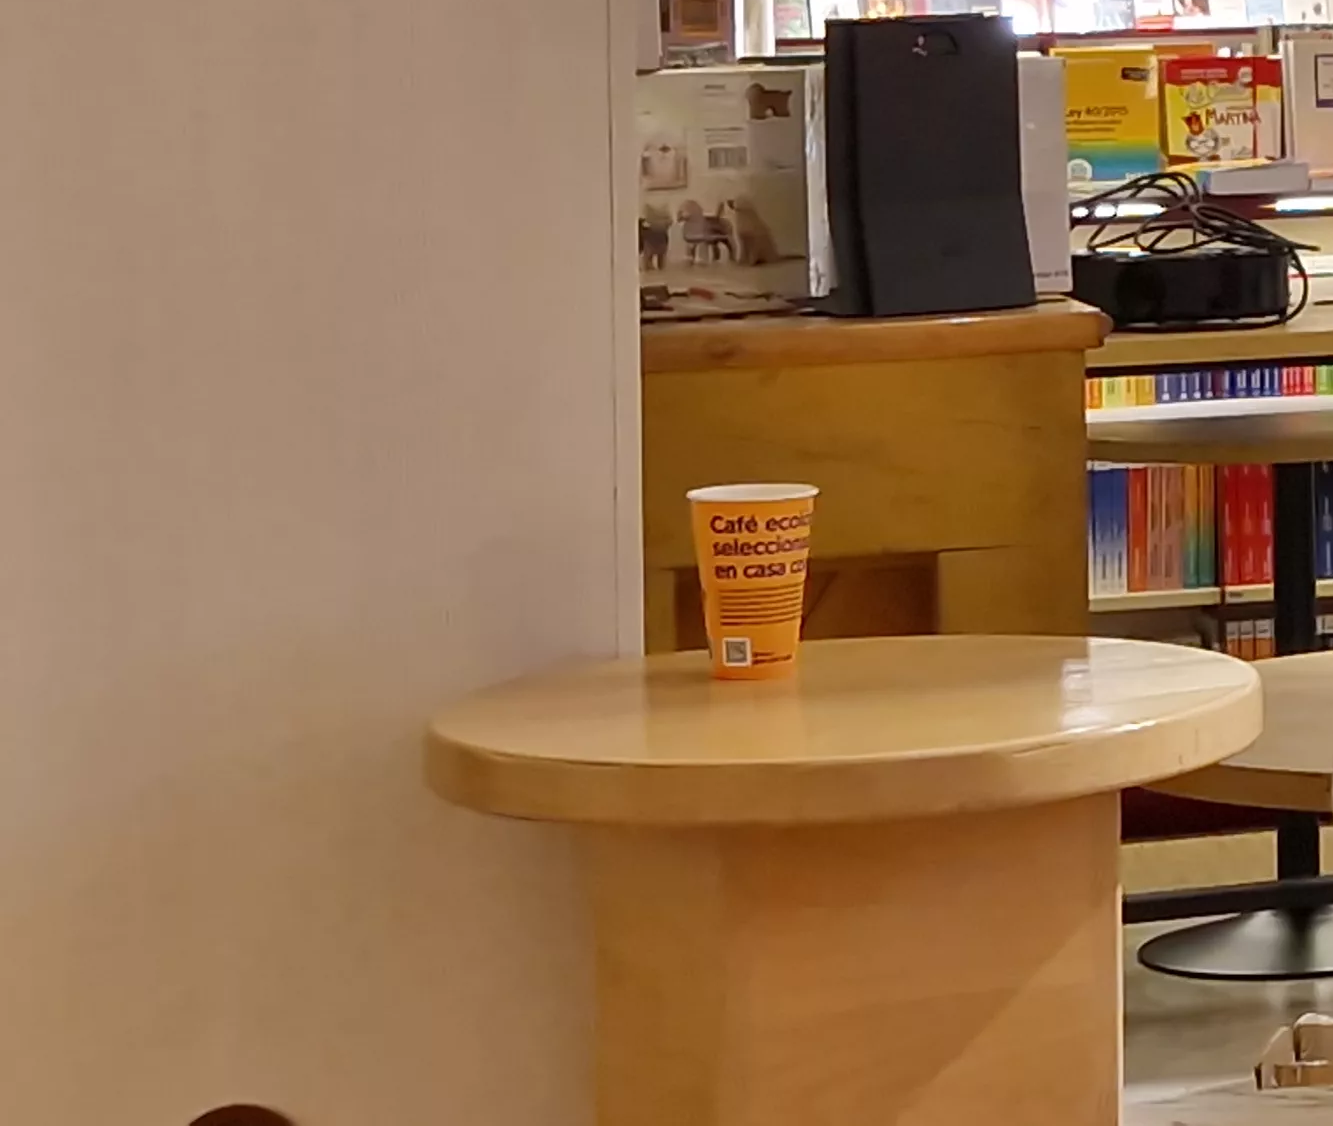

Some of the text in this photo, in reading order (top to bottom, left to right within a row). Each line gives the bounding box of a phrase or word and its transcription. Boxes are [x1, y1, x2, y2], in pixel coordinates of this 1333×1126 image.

[710, 514, 758, 534] Café
[715, 564, 737, 579] en
[743, 562, 786, 579] casa
